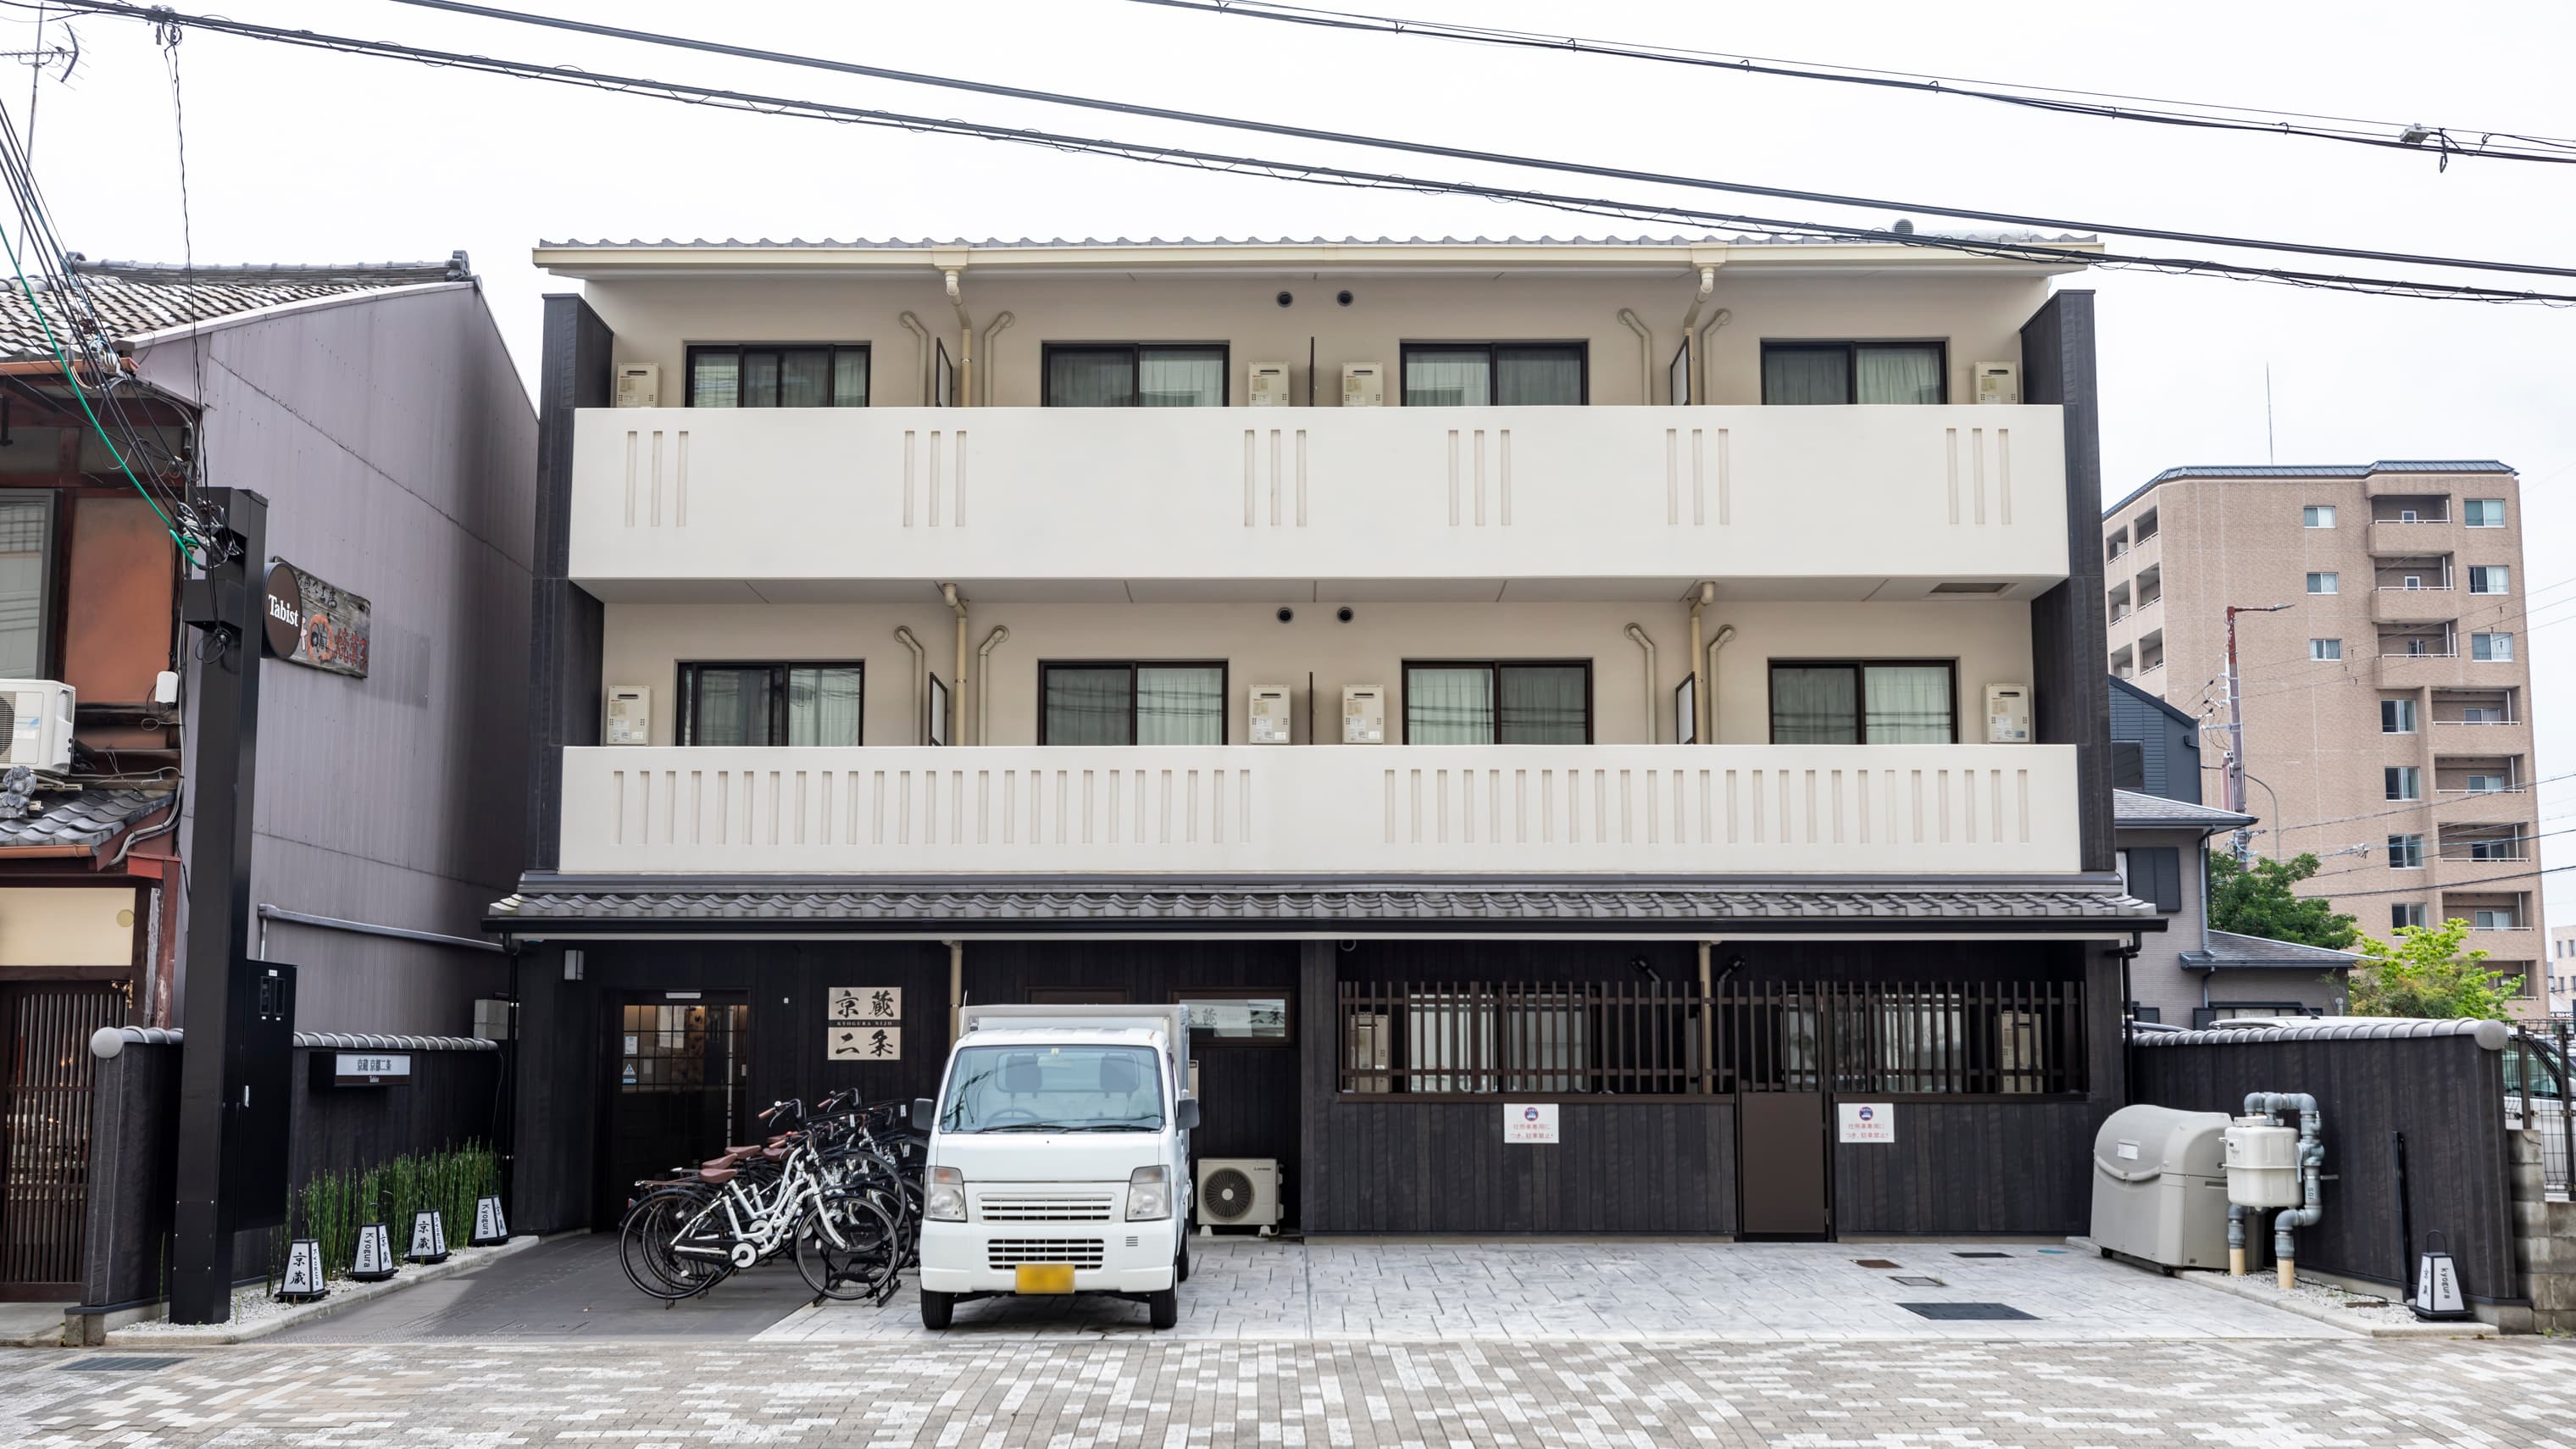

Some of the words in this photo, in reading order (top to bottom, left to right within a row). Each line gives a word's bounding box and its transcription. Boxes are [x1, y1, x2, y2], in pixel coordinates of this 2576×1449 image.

[268, 594, 298, 627] Tabist
[835, 990, 894, 1018] 京蔵
[835, 1029, 894, 1058] 二条
[416, 1220, 430, 1250] 京蔵
[481, 1203, 490, 1235] Kyogura
[363, 1232, 374, 1269] Kyogura
[290, 1252, 308, 1285] 京蔵
